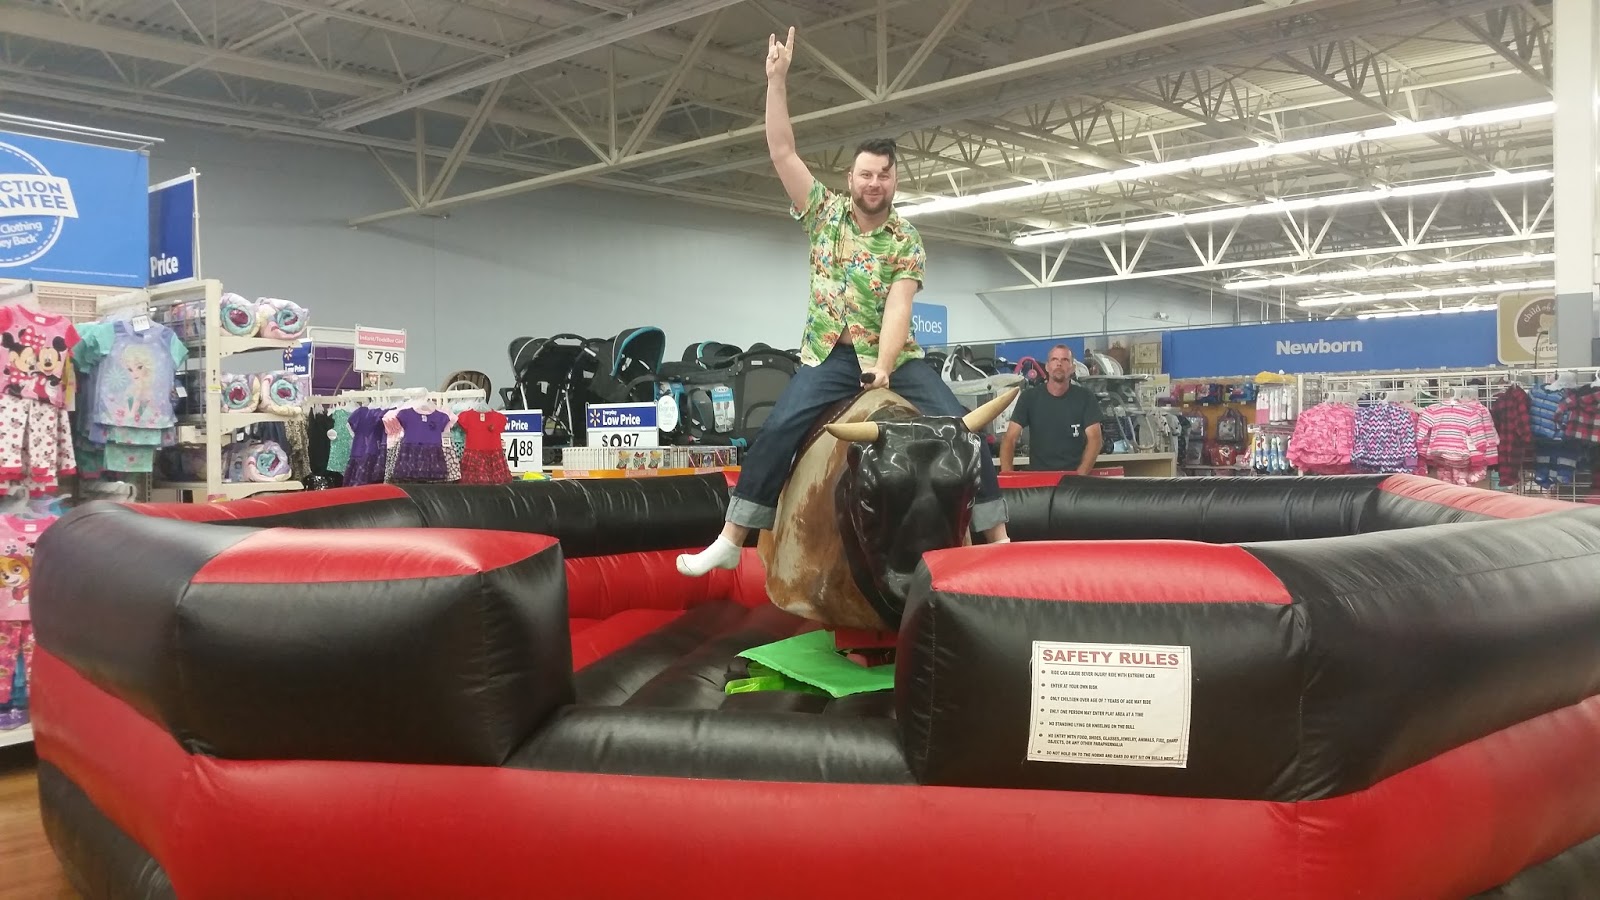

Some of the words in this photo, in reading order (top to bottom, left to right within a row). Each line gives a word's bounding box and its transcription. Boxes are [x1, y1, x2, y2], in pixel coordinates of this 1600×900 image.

[1, 221, 43, 233] Clothing
[149, 252, 179, 278] Price
[911, 314, 943, 334] Shoes
[1276, 338, 1363, 356] Newborn
[367, 350, 399, 364] $796
[511, 419, 529, 431] Price
[602, 415, 620, 426] Low
[620, 413, 641, 425] Price
[1042, 649, 1113, 663] SAFETY
[1119, 652, 1179, 666] RULES
